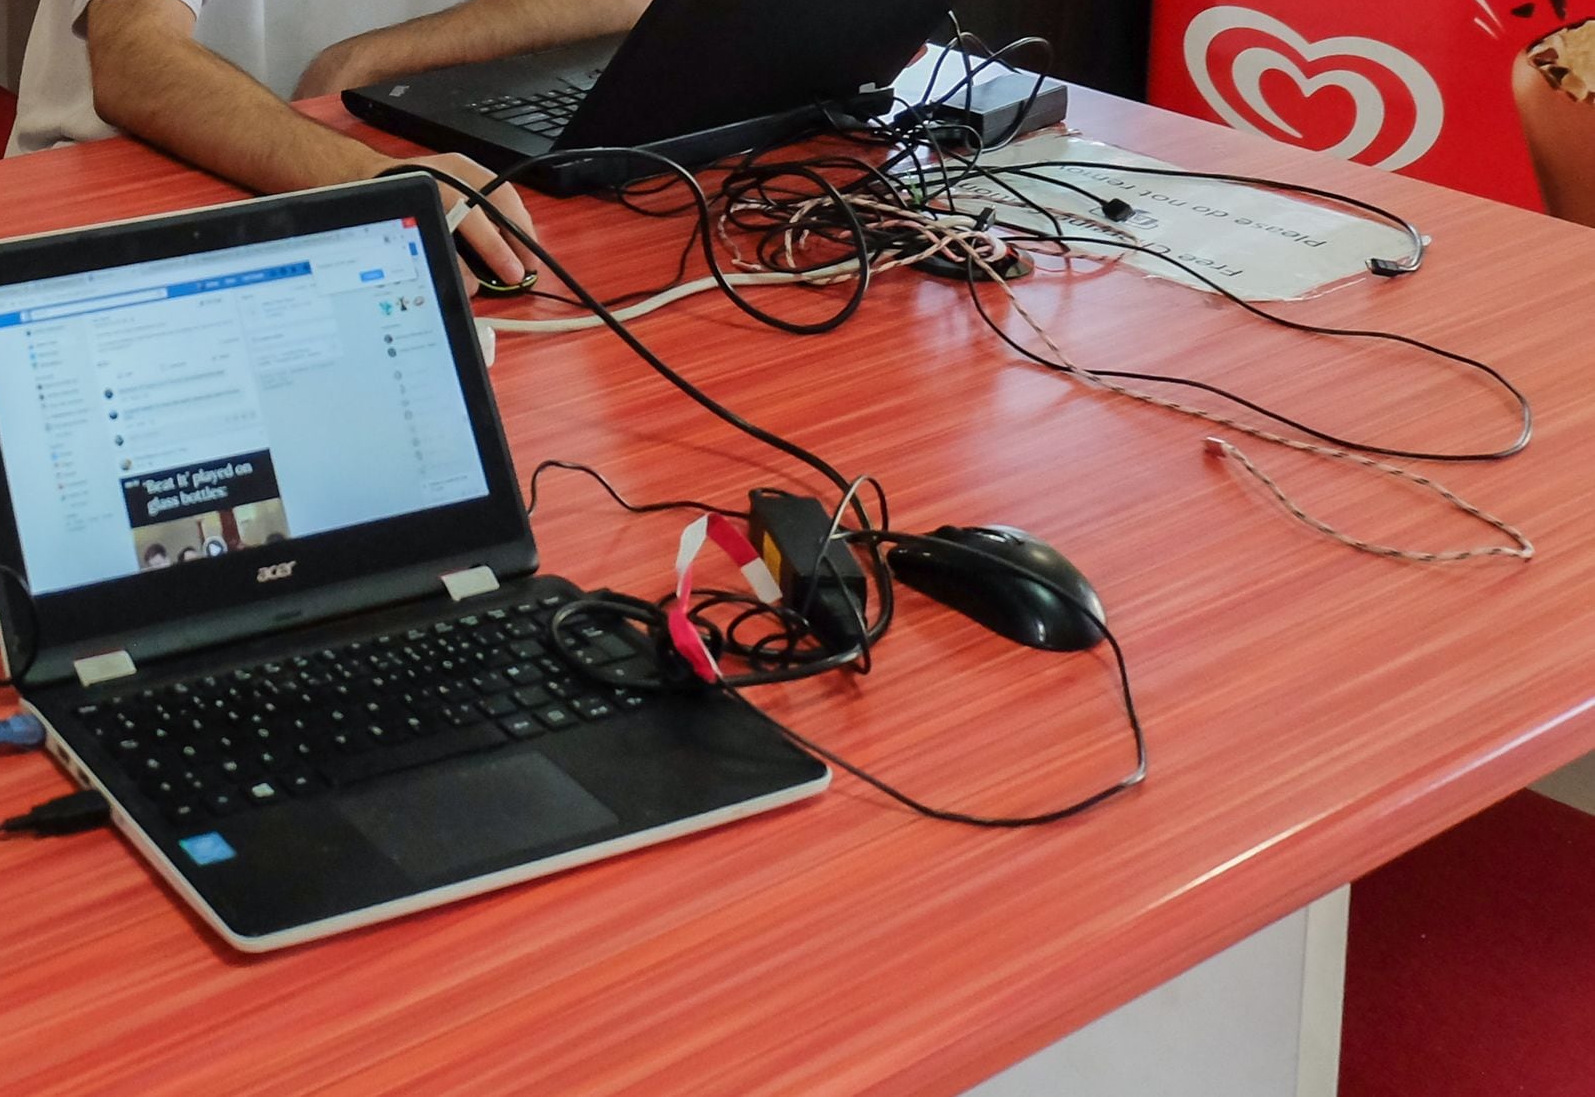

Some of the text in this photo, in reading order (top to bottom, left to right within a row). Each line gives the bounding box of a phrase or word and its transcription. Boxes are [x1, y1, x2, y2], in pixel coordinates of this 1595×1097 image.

[1137, 188, 1188, 213] not
[1191, 204, 1230, 225] do
[1234, 215, 1327, 250] Please
[1174, 252, 1244, 279] Free
[192, 463, 234, 488] played
[235, 462, 253, 475] on
[147, 495, 180, 517] glass
[257, 561, 297, 583] acer
